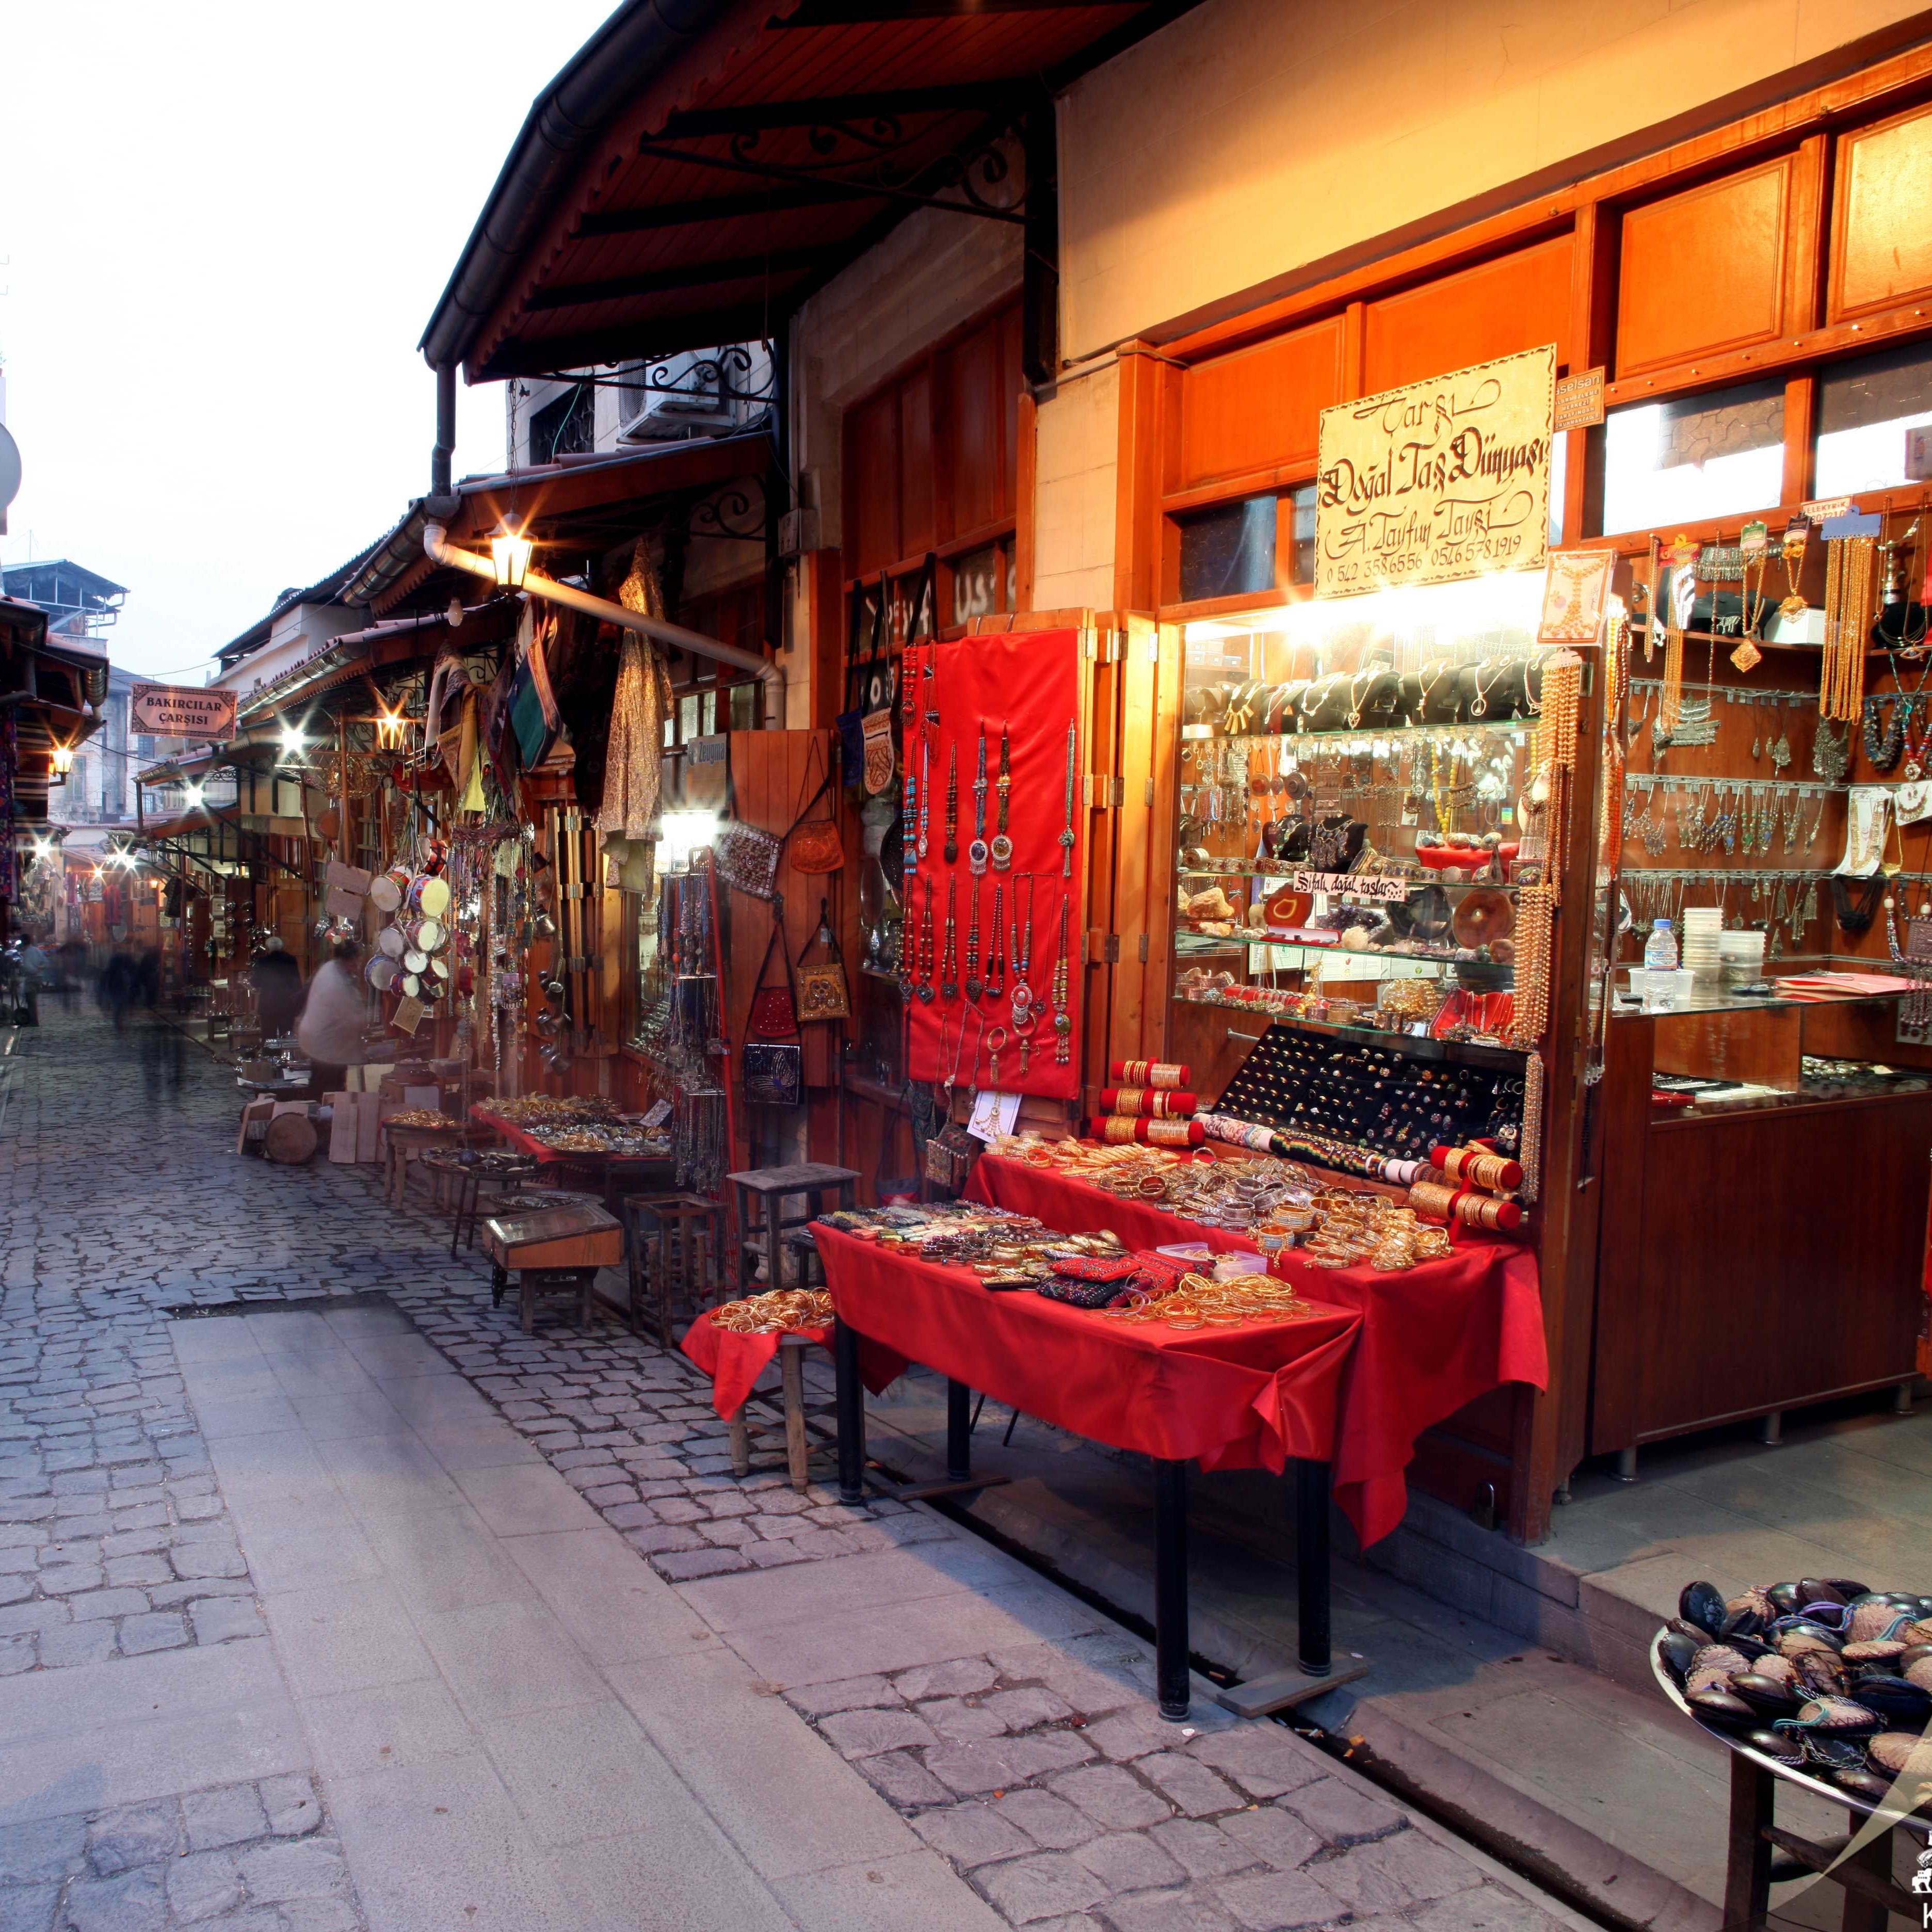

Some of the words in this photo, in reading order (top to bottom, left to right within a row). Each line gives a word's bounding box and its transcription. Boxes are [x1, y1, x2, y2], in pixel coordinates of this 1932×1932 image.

[1321, 445, 1392, 516] Doğal
[147, 697, 222, 712] BAKIRCILAR
[158, 712, 208, 726] ÇARŞISI
[699, 741, 725, 765] Zeugma
